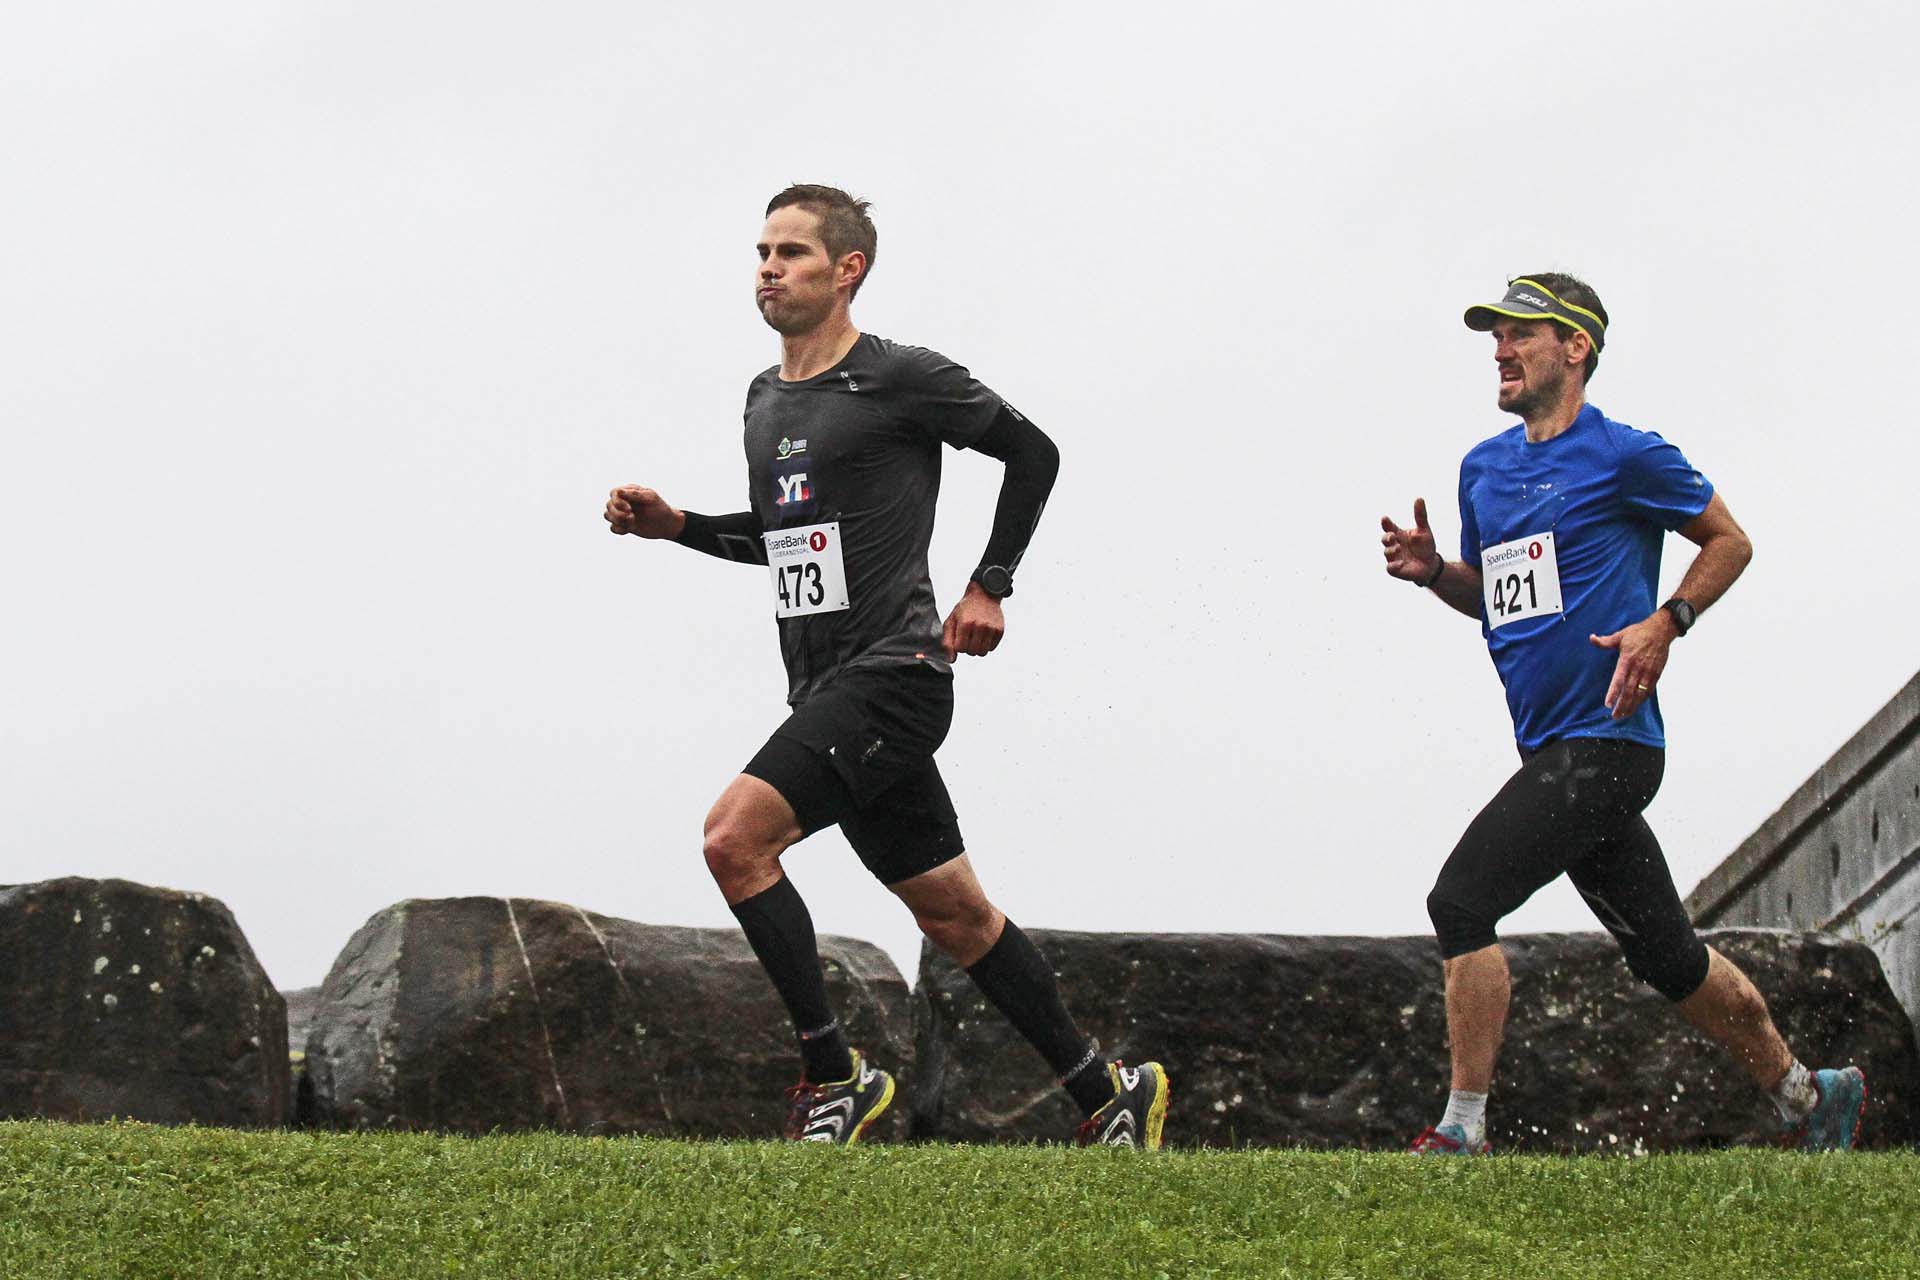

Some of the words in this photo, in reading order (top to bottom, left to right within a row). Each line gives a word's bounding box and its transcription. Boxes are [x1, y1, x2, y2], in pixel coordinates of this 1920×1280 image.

[1516, 292, 1548, 307] 2XU
[767, 533, 808, 550] SpareBank
[1486, 545, 1527, 566] SpareBank
[778, 562, 825, 608] 473
[1493, 569, 1538, 617] 421
